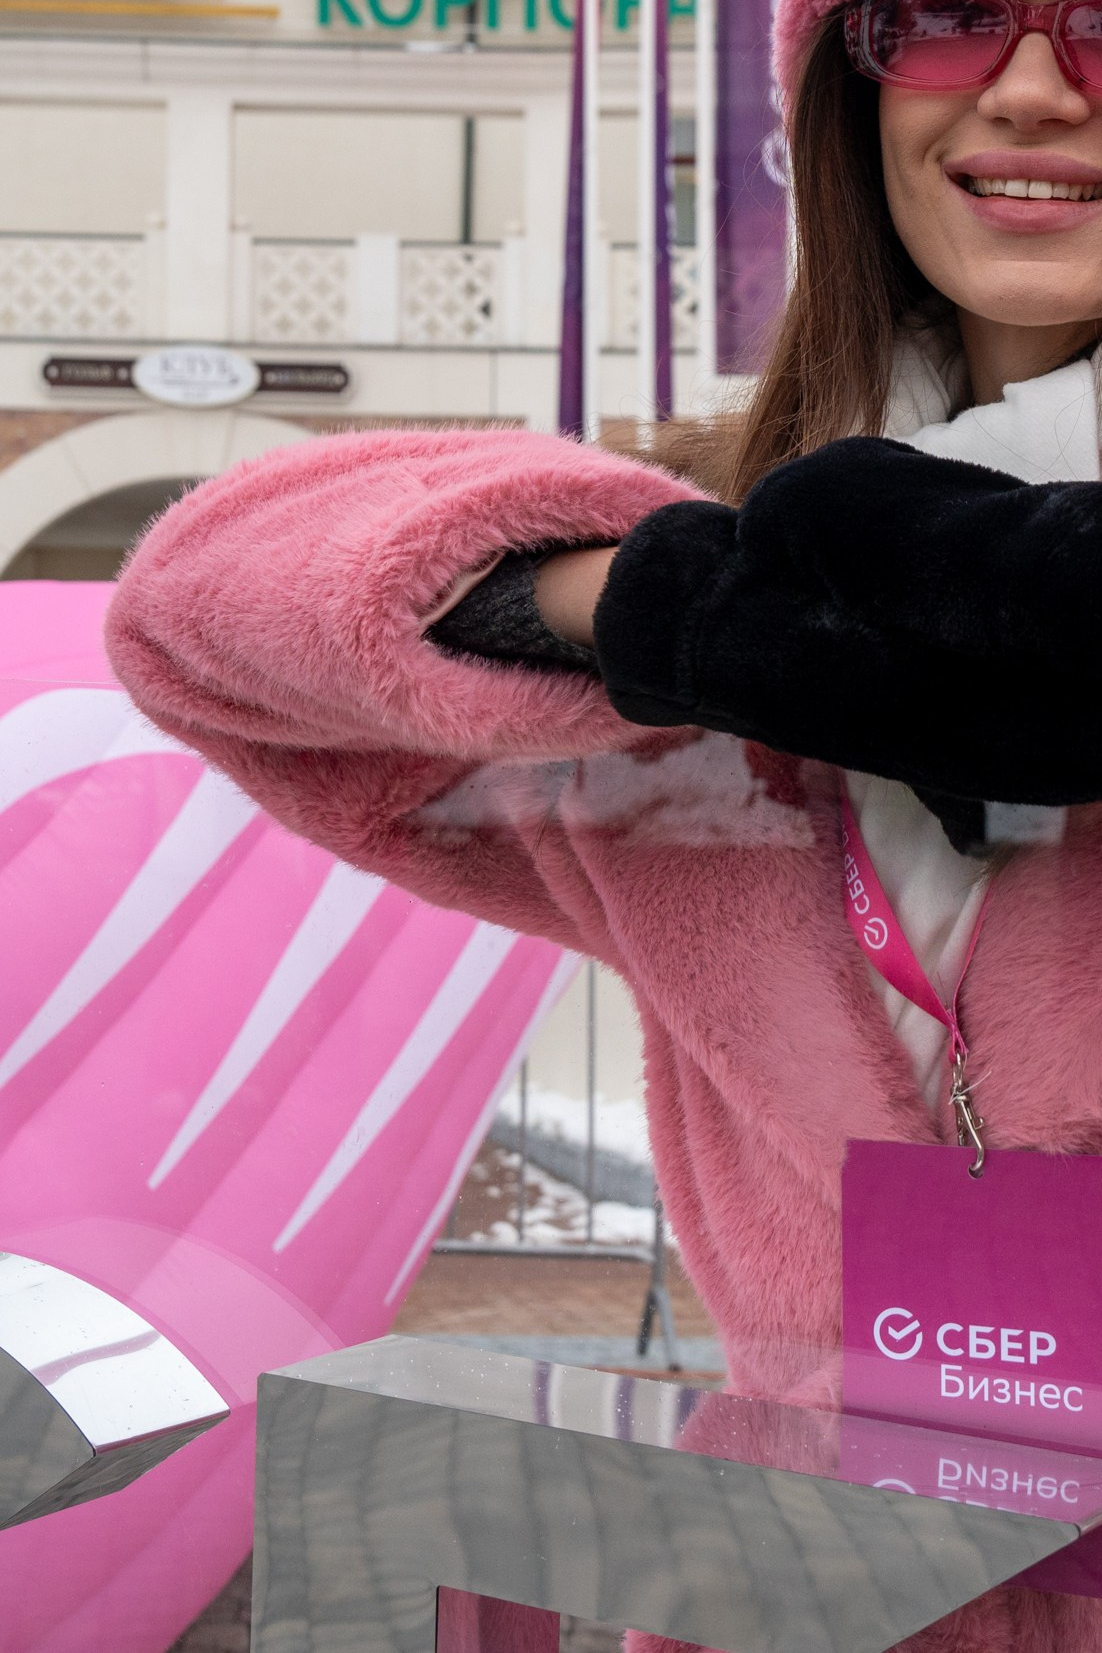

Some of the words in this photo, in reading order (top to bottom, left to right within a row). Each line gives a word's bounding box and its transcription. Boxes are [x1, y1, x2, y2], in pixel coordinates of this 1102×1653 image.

[843, 853, 871, 905] СБЕР
[936, 1322, 1057, 1365] СБЕР
[940, 1363, 1084, 1413] Бизнес
